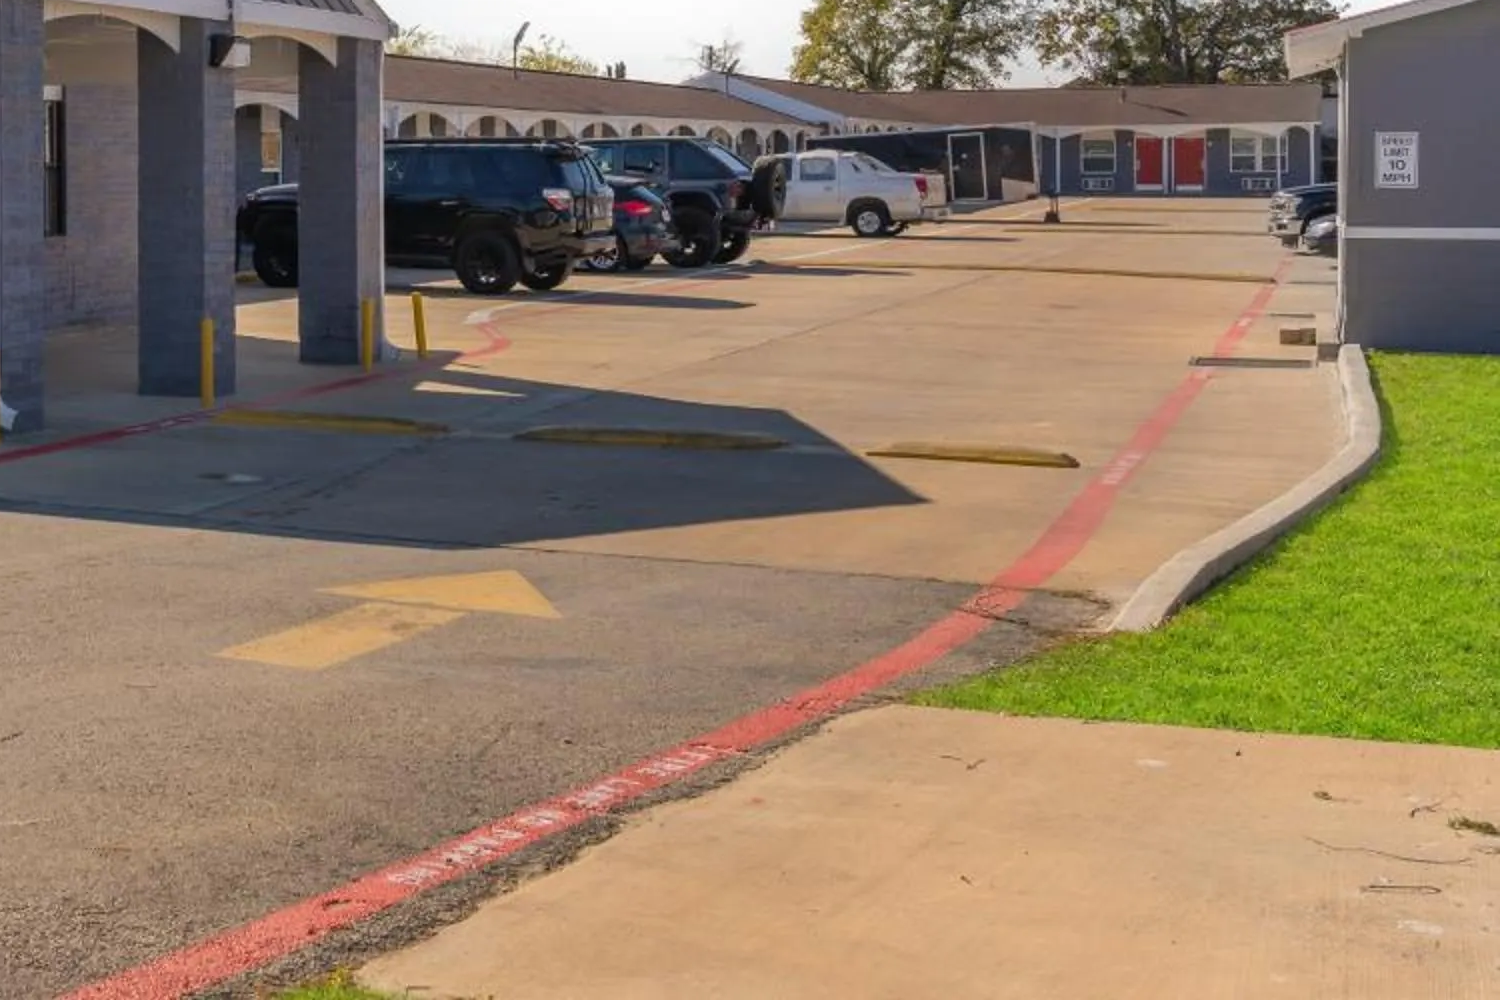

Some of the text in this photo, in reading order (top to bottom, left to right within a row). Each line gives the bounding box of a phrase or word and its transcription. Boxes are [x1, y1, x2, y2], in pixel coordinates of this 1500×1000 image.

[1383, 147, 1410, 157] LIMIT
[1388, 159, 1406, 170] 10
[1382, 172, 1411, 182] MPH
